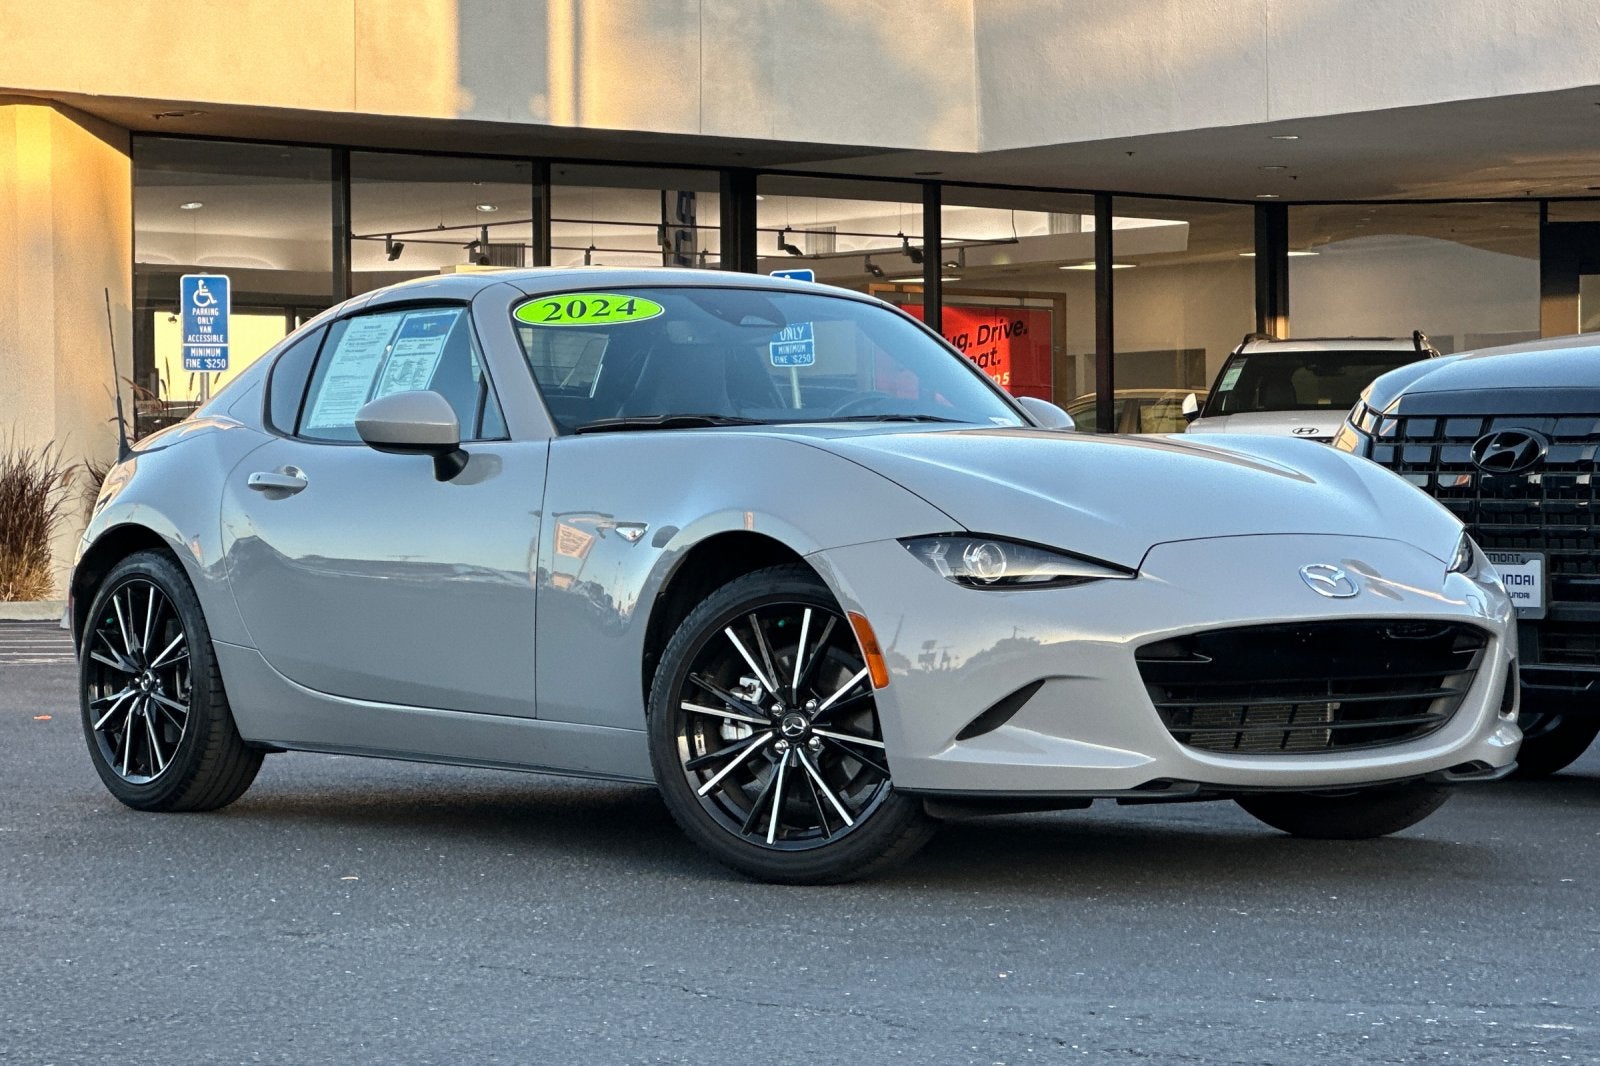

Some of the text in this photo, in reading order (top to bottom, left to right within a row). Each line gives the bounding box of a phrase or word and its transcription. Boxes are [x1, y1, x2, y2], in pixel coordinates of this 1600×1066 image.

[192, 307, 219, 316] PARKING
[543, 299, 637, 321] 2024
[197, 316, 213, 324] ONLY
[199, 325, 212, 333] VAN
[779, 326, 804, 341] ONLY
[187, 334, 224, 342] ACCESSIBLE
[943, 319, 1028, 354] ug. Drive.
[190, 347, 221, 357] MINIMUM
[778, 344, 806, 354] MINIMUM
[185, 358, 226, 368] FINE $250
[774, 355, 788, 363] FINE
[1485, 553, 1521, 563] MONT
[1508, 591, 1530, 599] UNDAI
